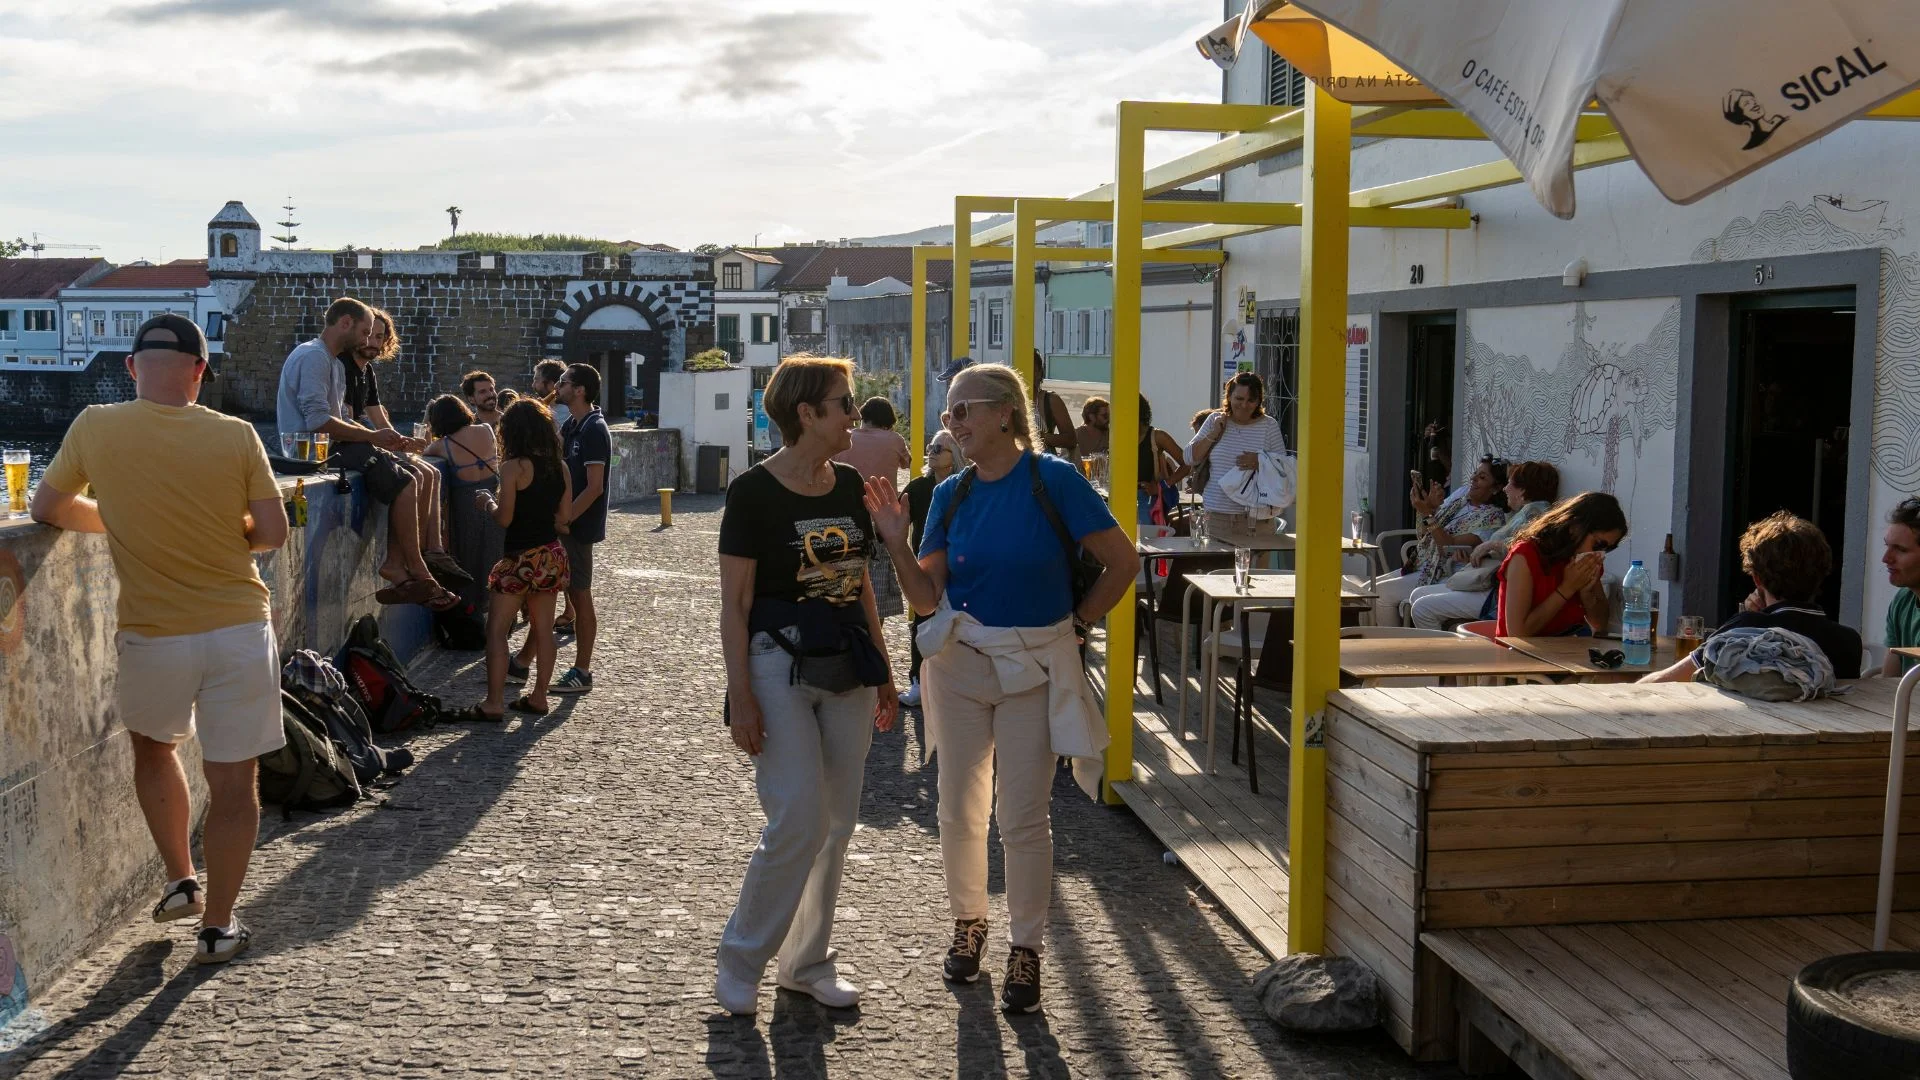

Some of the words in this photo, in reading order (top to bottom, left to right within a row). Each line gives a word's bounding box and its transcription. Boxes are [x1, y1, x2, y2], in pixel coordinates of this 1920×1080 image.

[1462, 59, 1476, 79] O
[1475, 68, 1509, 105] CAFÉ
[1780, 46, 1888, 111] SICAL
[1409, 264, 1424, 285] 20
